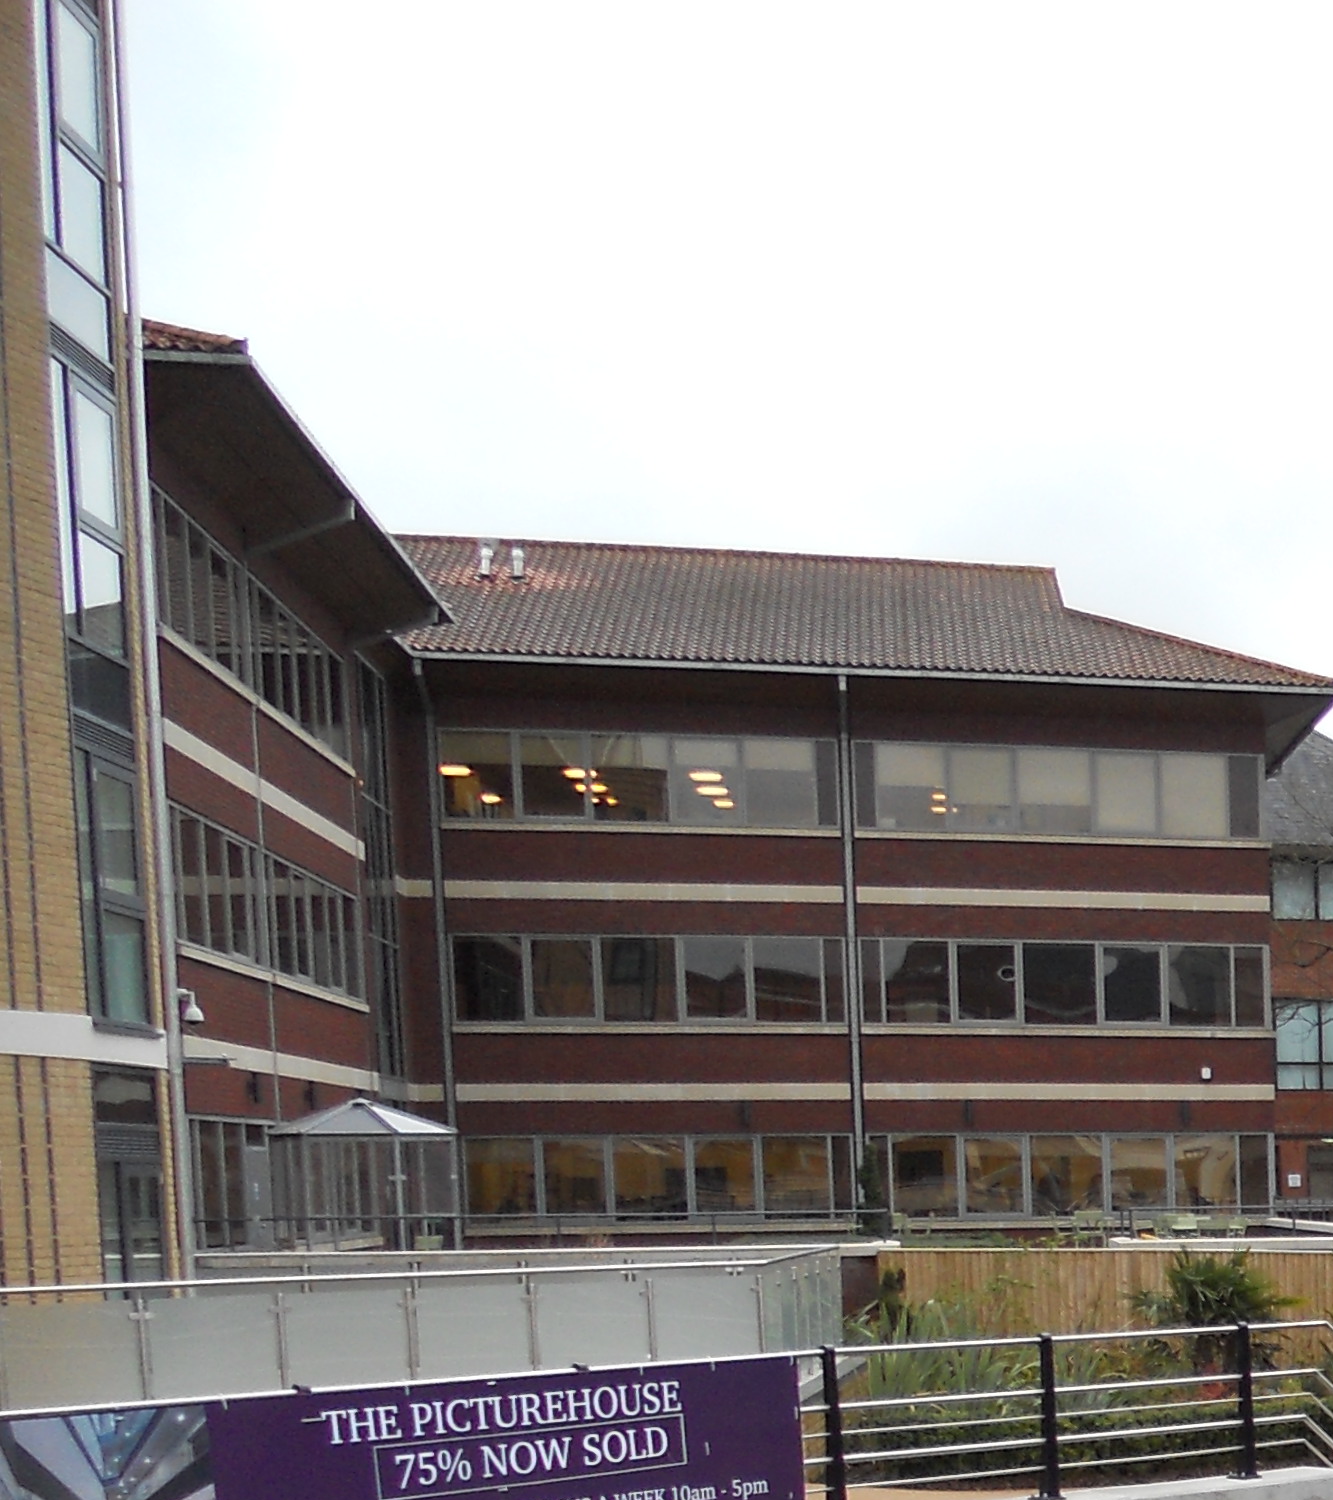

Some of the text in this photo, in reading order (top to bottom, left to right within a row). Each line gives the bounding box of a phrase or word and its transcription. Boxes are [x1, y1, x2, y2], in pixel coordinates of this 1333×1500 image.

[321, 1380, 683, 1445] THE PICTUREHOUSE
[394, 1426, 668, 1490] 75% NOW SOLD
